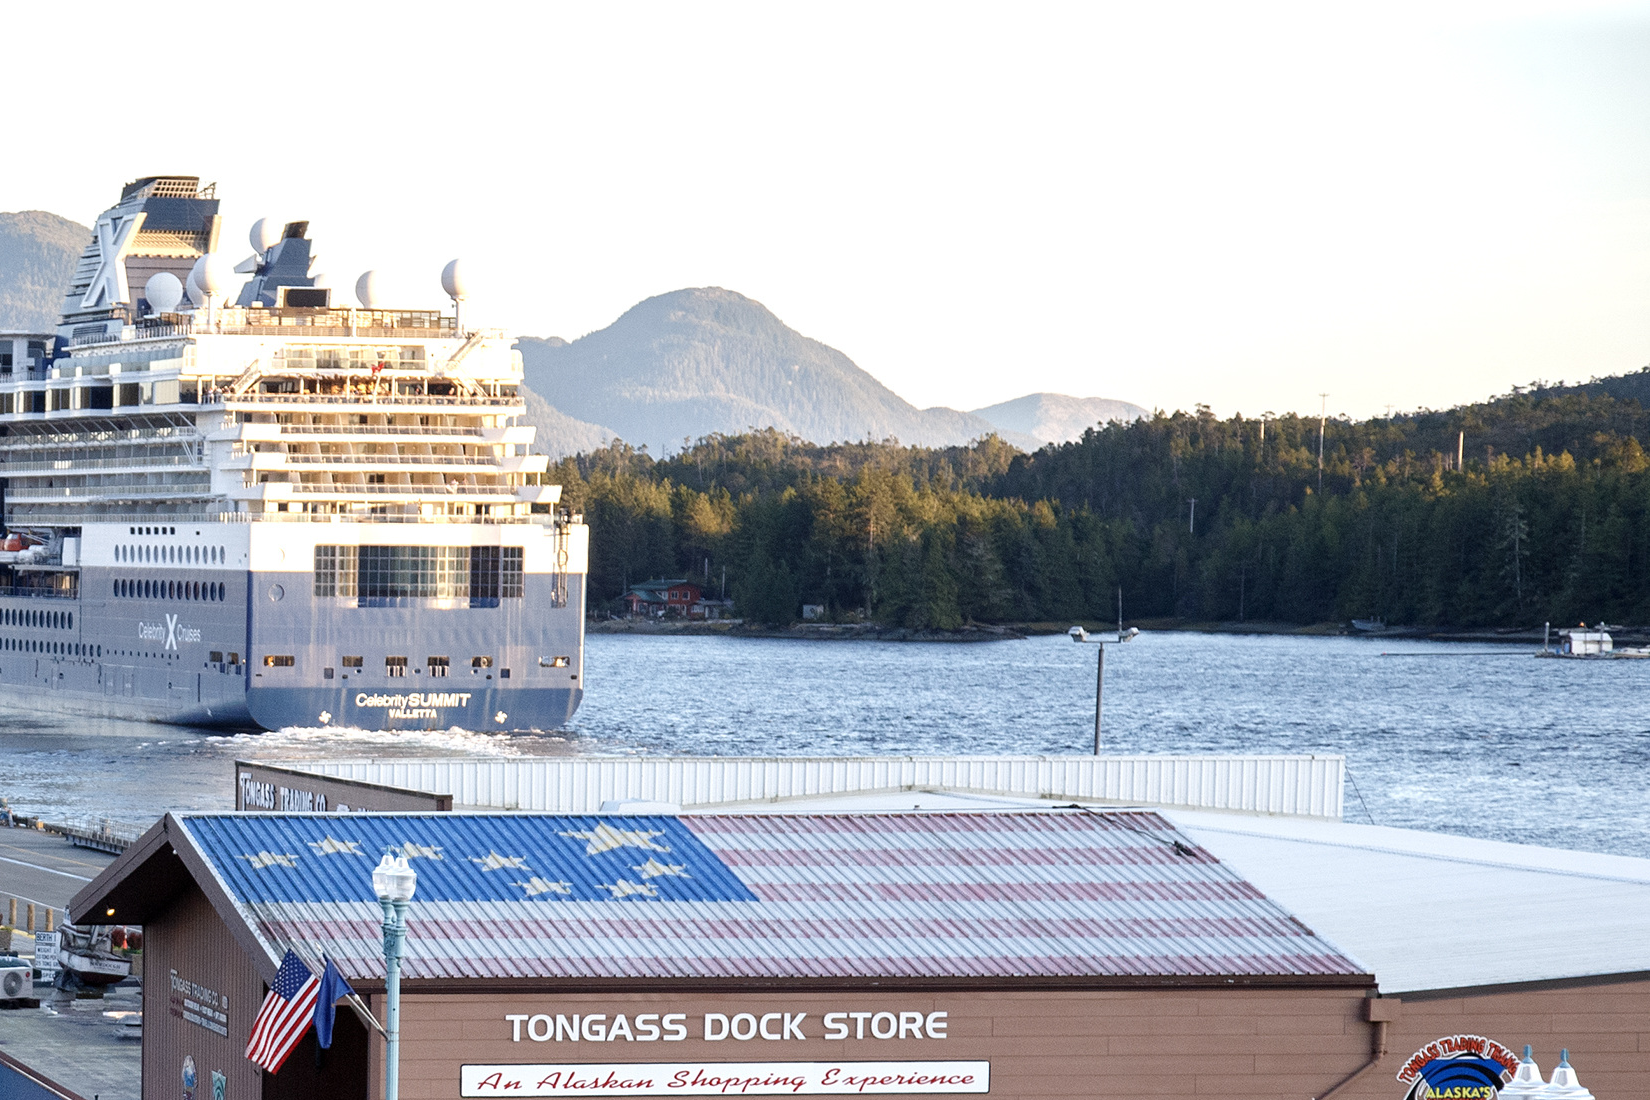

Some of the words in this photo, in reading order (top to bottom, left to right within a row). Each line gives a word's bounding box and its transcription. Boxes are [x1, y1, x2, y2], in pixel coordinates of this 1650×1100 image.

[138, 621, 166, 644] Celebrity
[165, 613, 178, 651] X
[176, 623, 201, 643] Cruises
[388, 708, 438, 719] VALLETTA
[240, 772, 276, 810] TONGASS
[279, 786, 314, 812] TRADING
[36, 933, 52, 941] BERTH
[505, 1013, 688, 1042] TONGASS
[704, 1012, 807, 1041] DOCK
[823, 1011, 949, 1040] STORE
[1398, 1043, 1441, 1082] TONGASS
[1439, 1036, 1487, 1054] TRADING
[1488, 1042, 1520, 1079] TRIANG
[477, 1072, 523, 1091] An
[536, 1070, 655, 1091] Alaskan
[666, 1069, 808, 1093] Shopping
[820, 1068, 976, 1093] Experience
[1426, 1086, 1491, 1099] ALASKA'S
